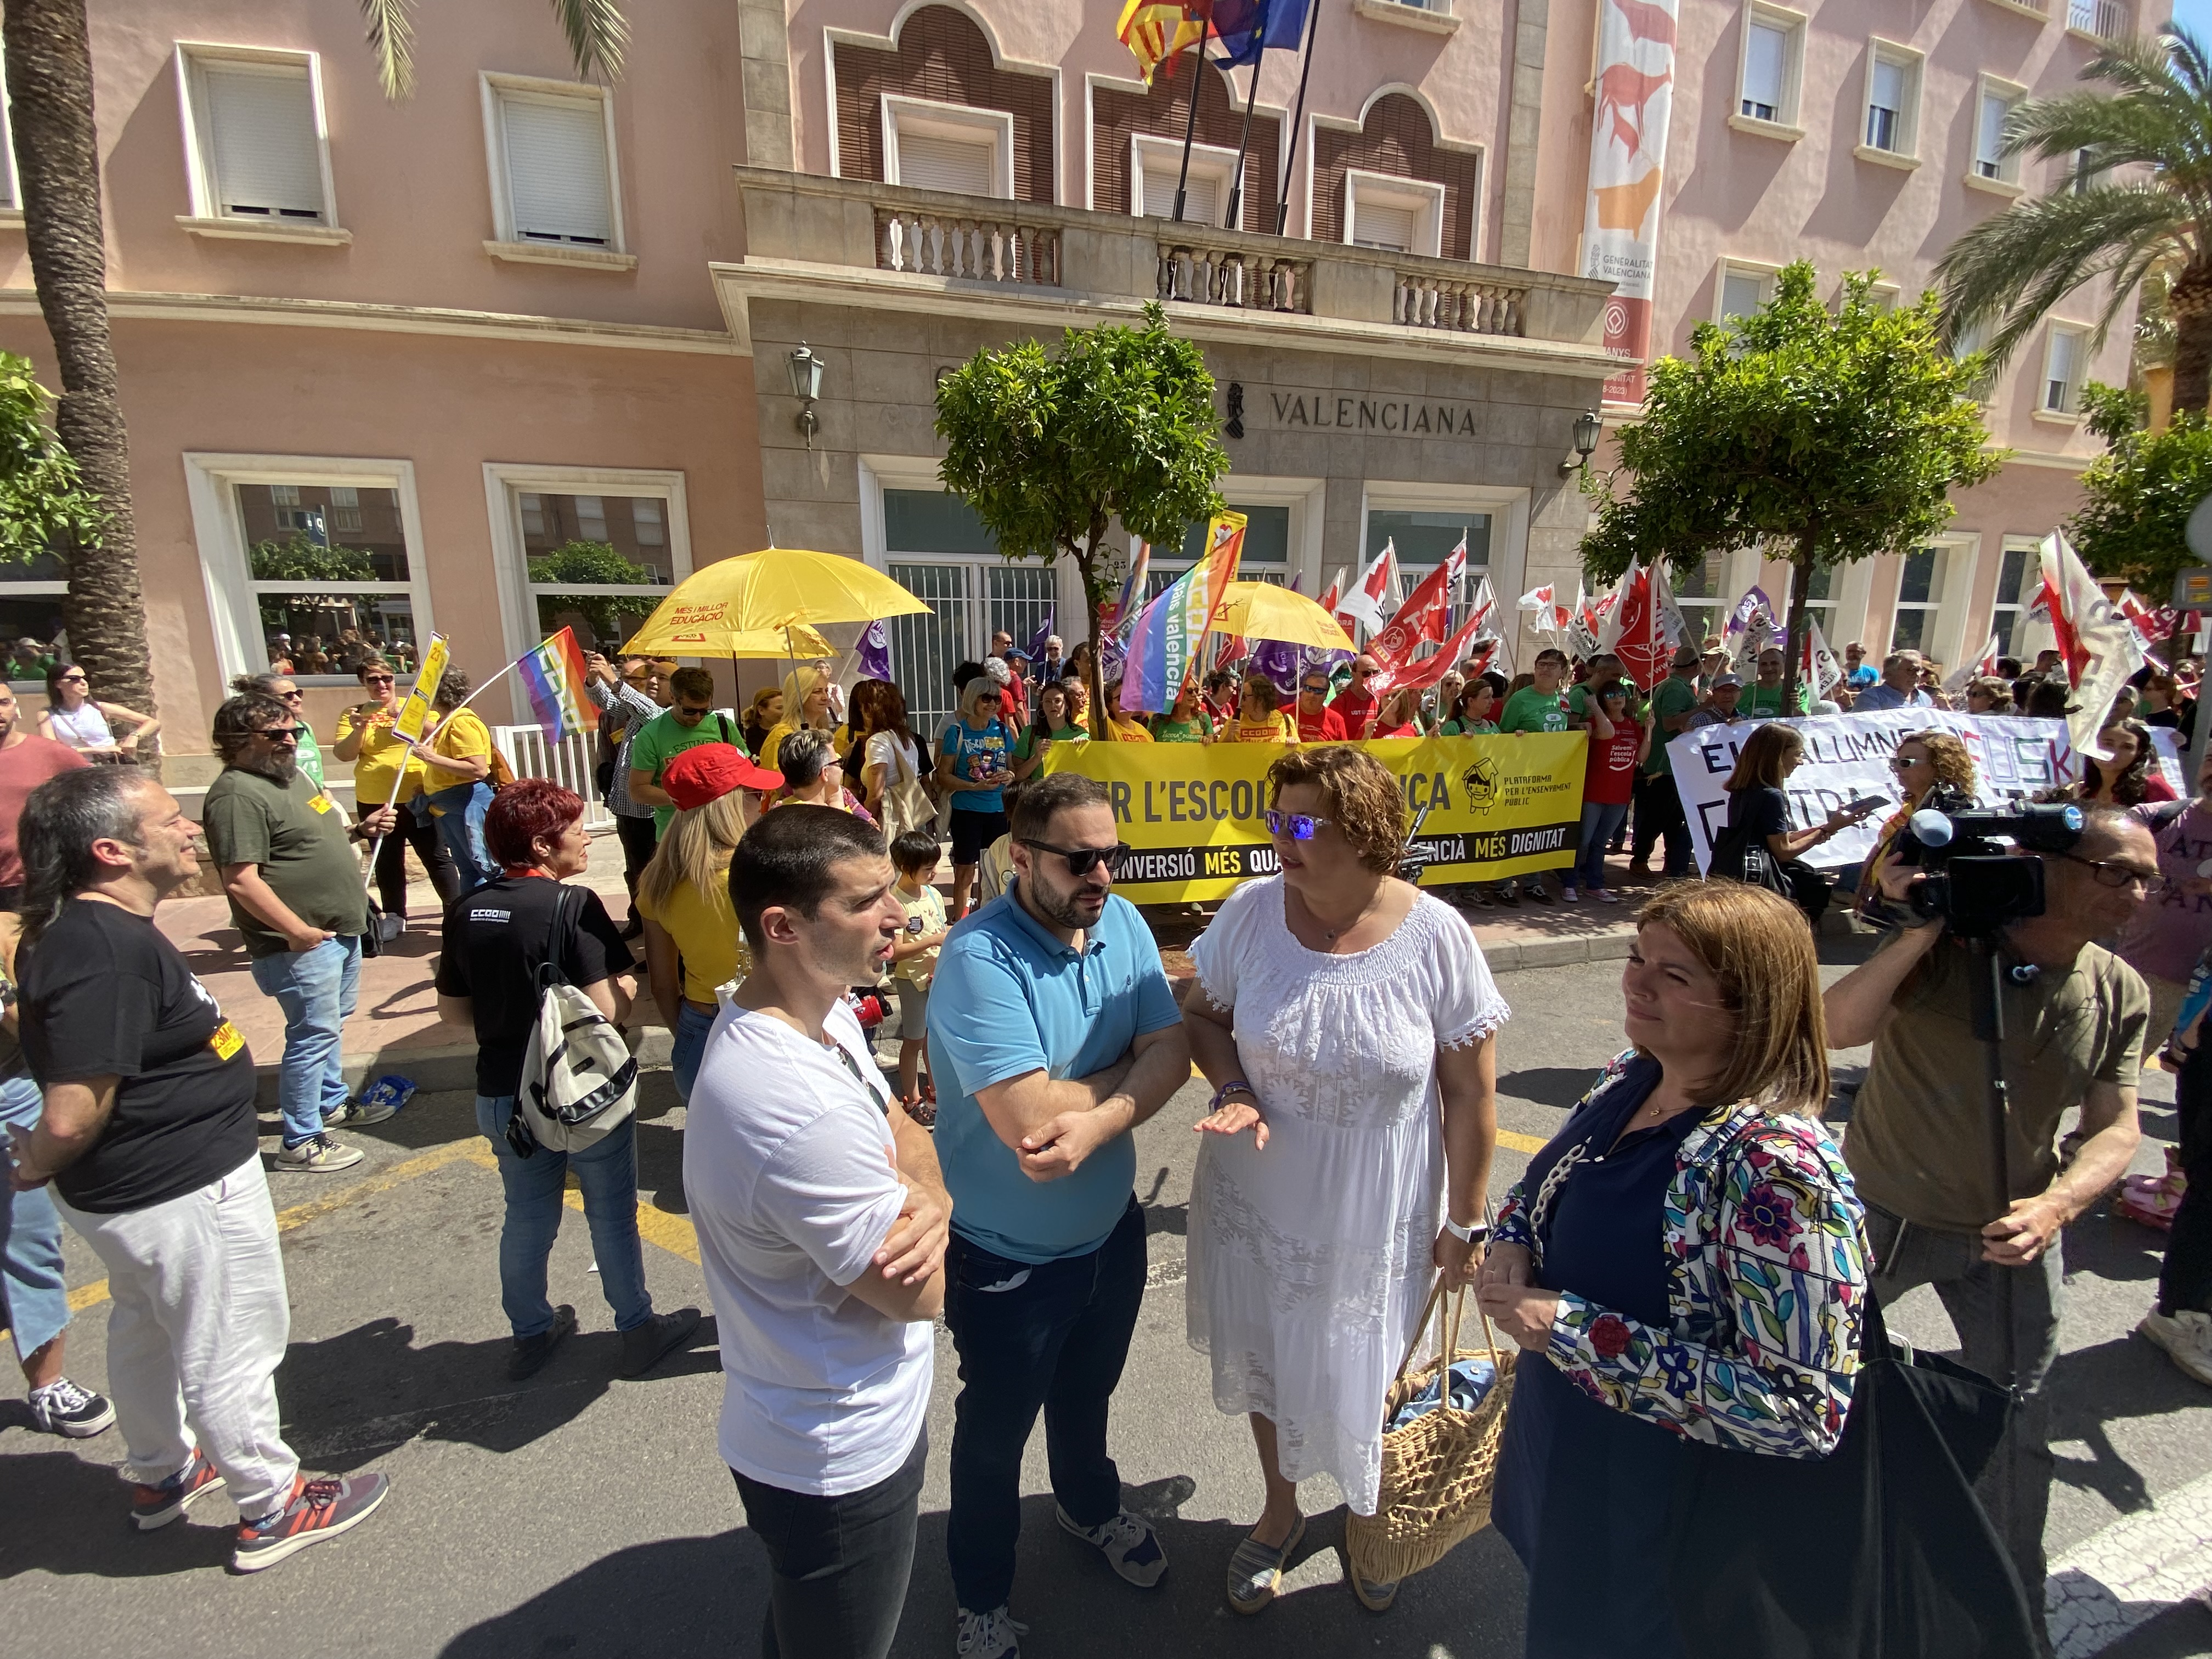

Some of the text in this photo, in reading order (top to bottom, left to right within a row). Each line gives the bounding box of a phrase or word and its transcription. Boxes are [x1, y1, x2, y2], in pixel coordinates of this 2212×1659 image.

[1603, 255, 1653, 269] GENERALITAT
[1603, 266, 1651, 280] VALENCIANA
[1606, 346, 1631, 358] ANYS
[1271, 393, 1476, 436] VALENCIANA
[1114, 561, 1126, 569] 23
[697, 602, 729, 612] MILLOR
[670, 610, 723, 625] EDUCACIÓ
[1504, 775, 1552, 785] PLATAFORMA
[1505, 787, 1520, 796] PER
[1144, 780, 1265, 822] L'ESCOL
[1205, 847, 1241, 875] MÉS
[1475, 831, 1506, 859] MÉS
[1511, 827, 1566, 854] DIGNITAT
